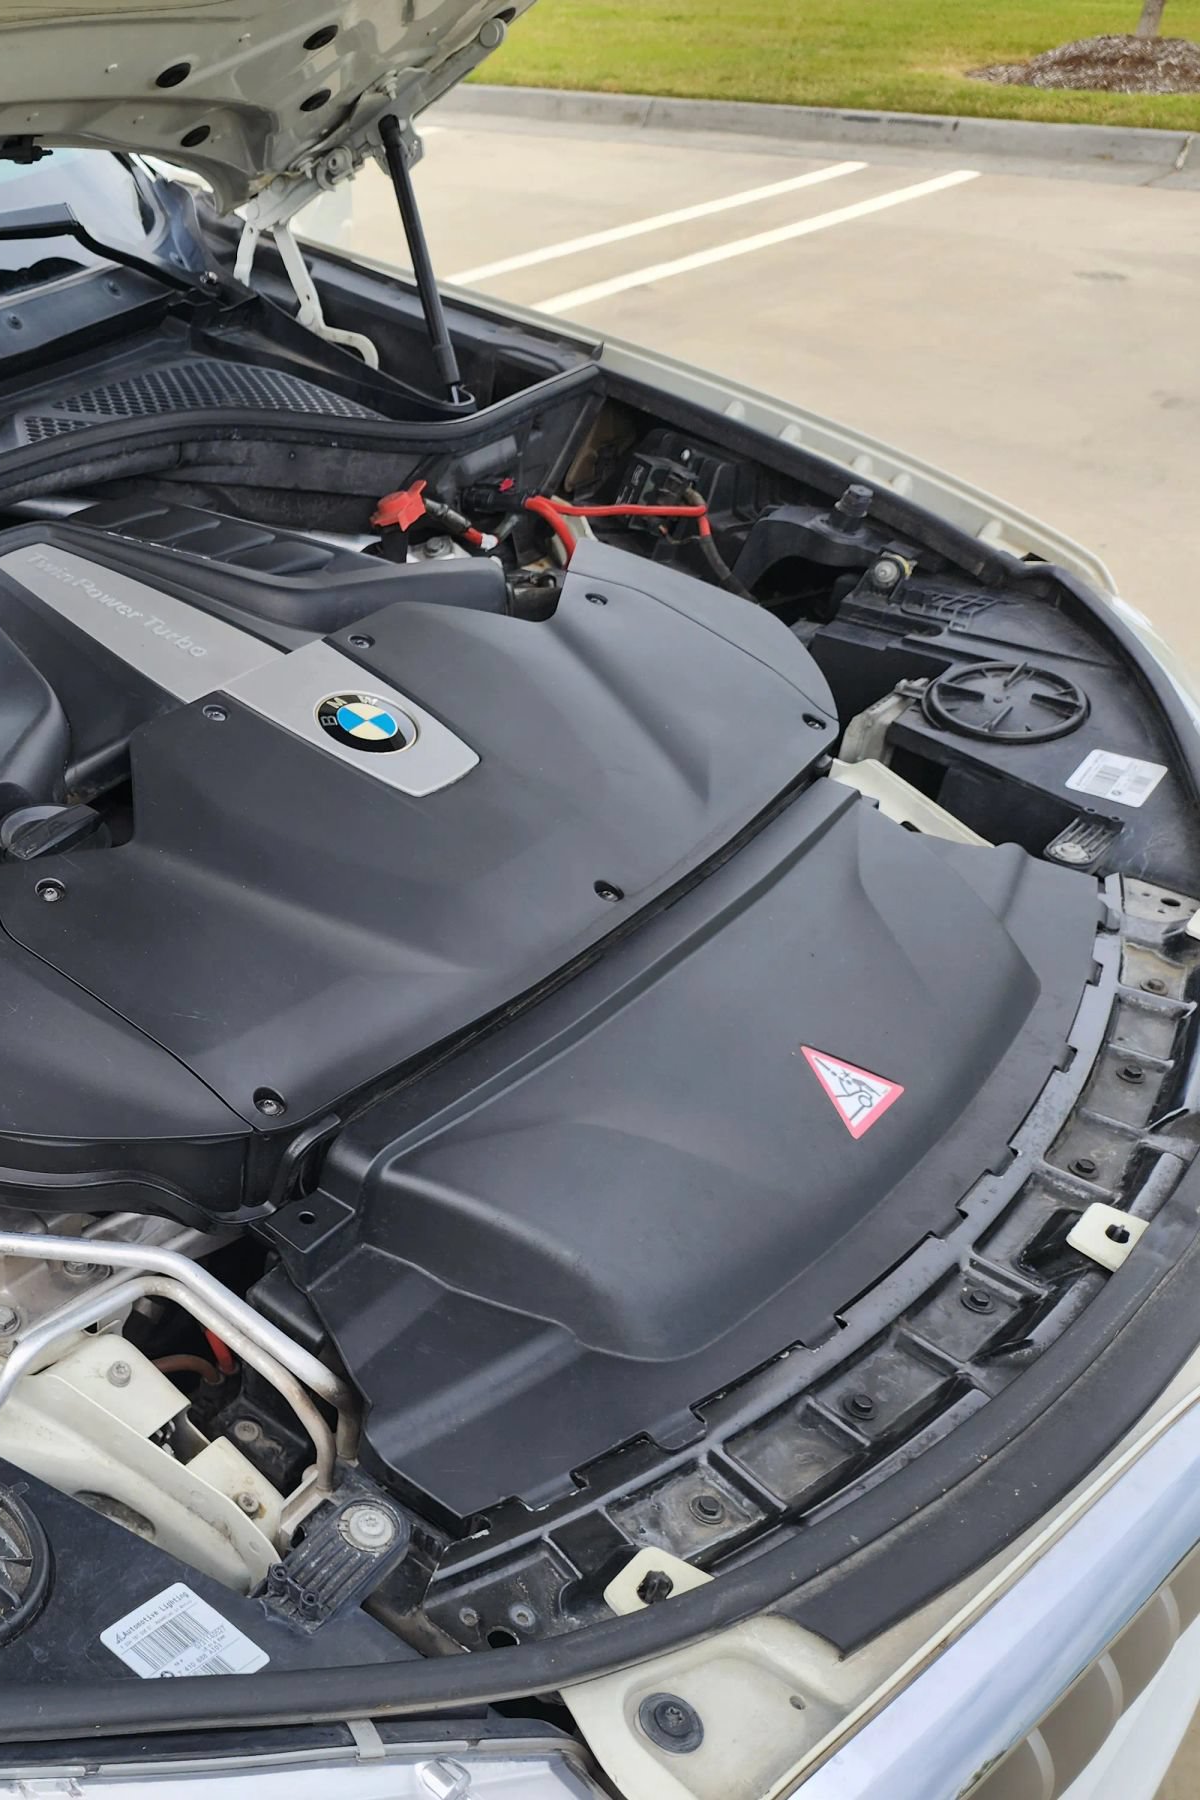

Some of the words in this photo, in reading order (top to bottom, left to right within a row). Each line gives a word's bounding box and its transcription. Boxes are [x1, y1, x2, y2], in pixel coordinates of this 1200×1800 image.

[144, 615, 208, 658] Turbo
[320, 695, 379, 727] BMW
[123, 1611, 159, 1637] Automotive
[159, 1592, 189, 1612] Lighting
